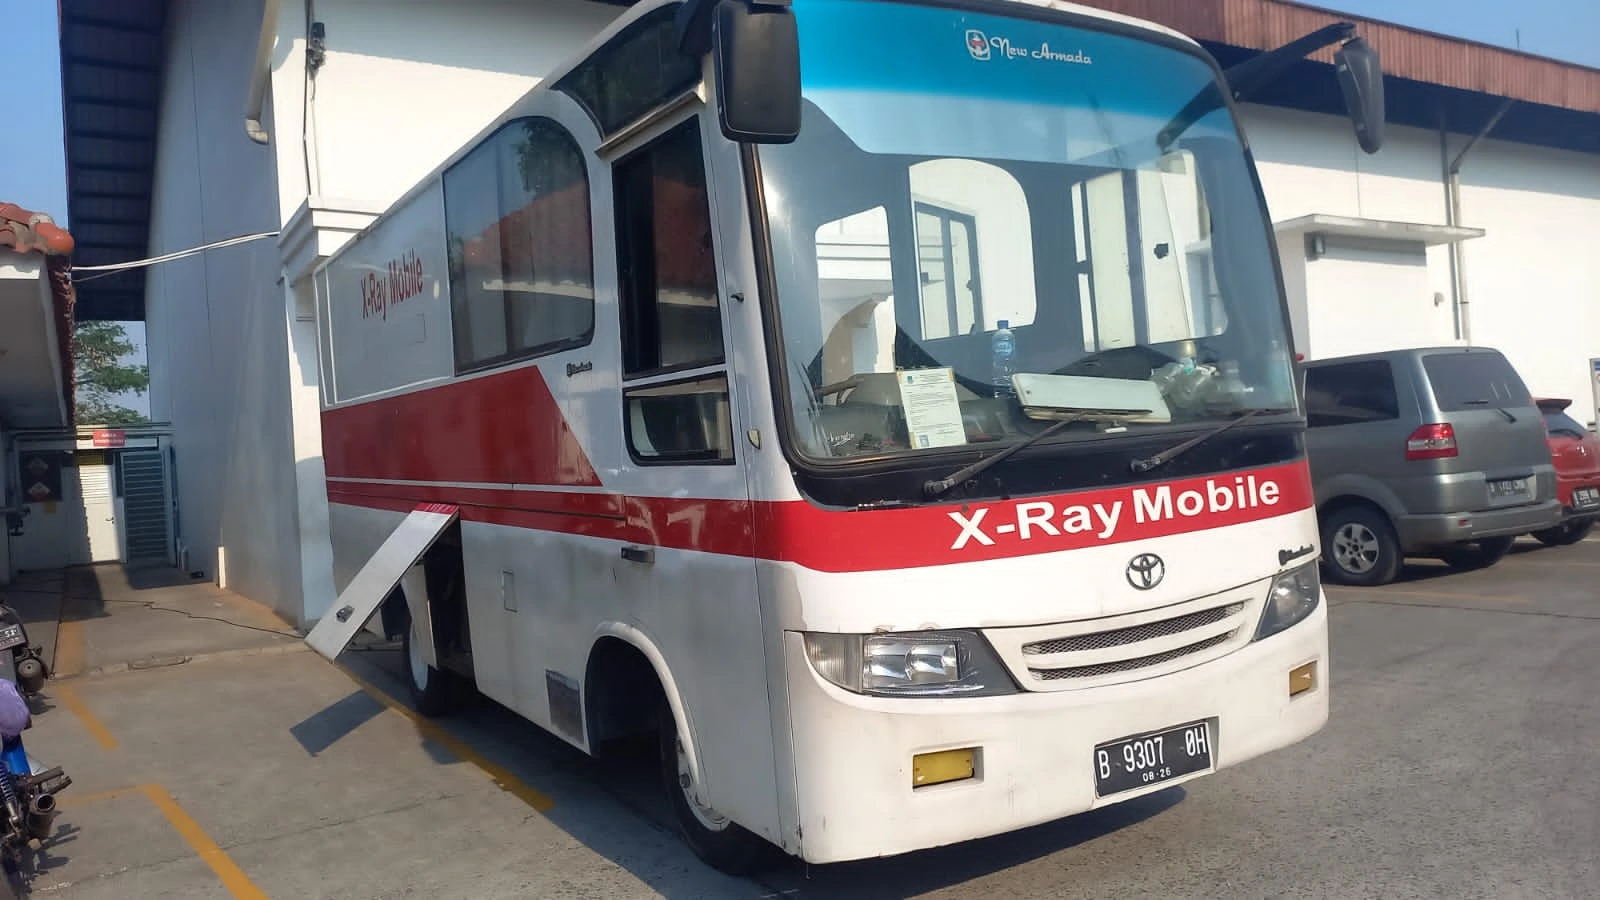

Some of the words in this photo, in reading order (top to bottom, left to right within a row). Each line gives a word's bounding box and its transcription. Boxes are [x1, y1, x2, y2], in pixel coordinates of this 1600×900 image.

[990, 36, 1028, 60] New
[1031, 42, 1092, 65] Armada
[360, 272, 387, 322] X-Ray
[388, 246, 424, 305] Mobile
[946, 500, 1123, 550] X-Ray
[1132, 475, 1280, 523] Mobile
[1097, 750, 1111, 780] B
[1123, 735, 1164, 773] 9307
